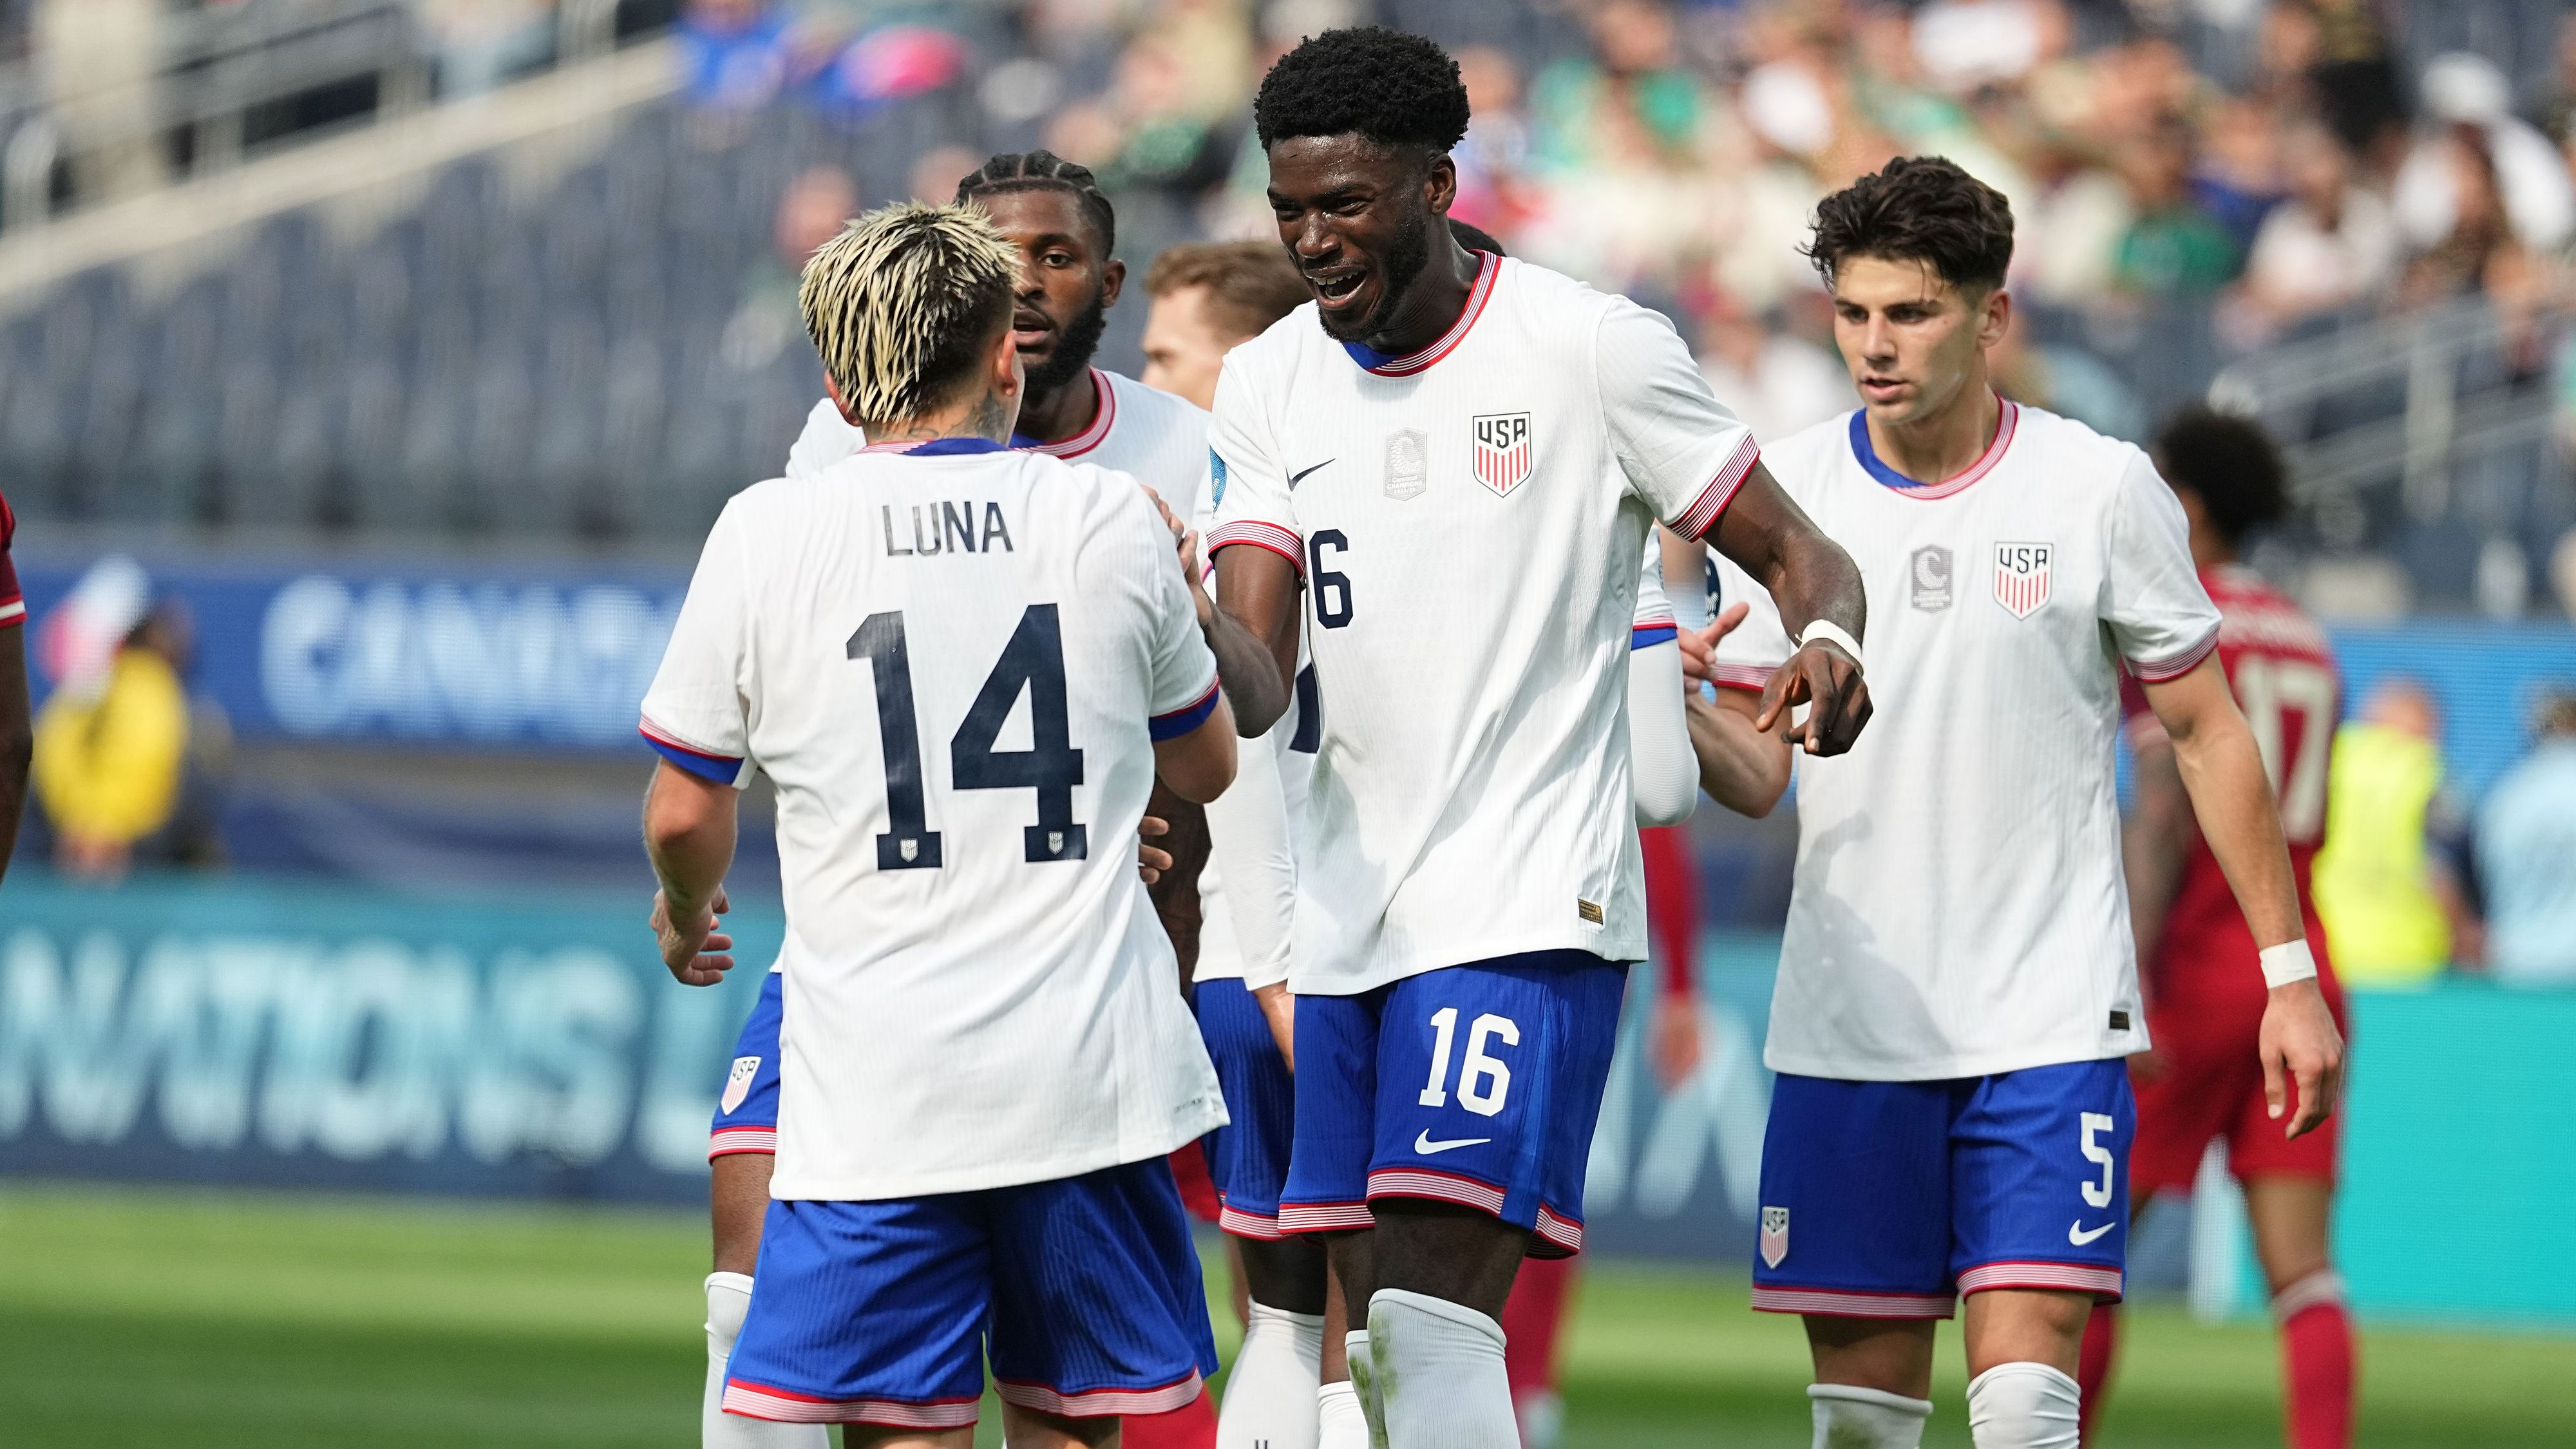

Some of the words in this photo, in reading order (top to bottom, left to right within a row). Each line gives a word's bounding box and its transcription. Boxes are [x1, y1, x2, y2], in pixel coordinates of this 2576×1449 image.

[1478, 418, 1526, 449] USA
[882, 500, 1014, 556] LUNA
[2000, 548, 2047, 574] USA
[846, 603, 1087, 871] 14
[2235, 649, 2339, 845] 17
[732, 1060, 757, 1081] USA
[1418, 1007, 1520, 1117] 16
[2080, 1112, 2114, 1208] 5
